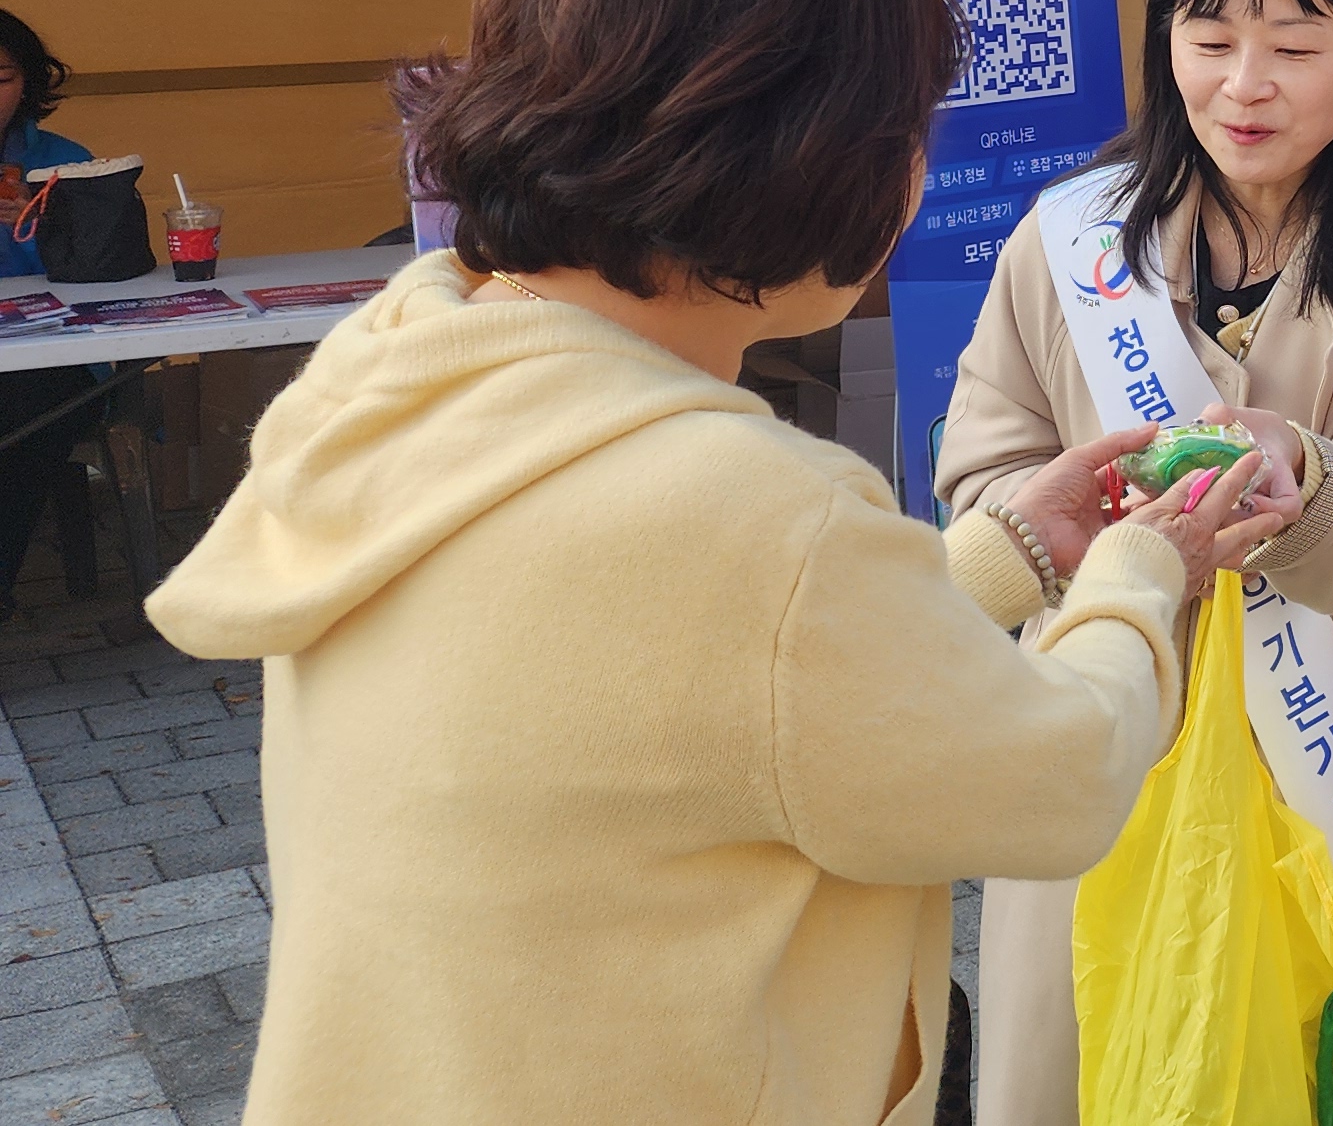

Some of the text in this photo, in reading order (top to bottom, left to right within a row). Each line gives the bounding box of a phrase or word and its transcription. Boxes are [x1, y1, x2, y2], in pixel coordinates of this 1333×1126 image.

[979, 125, 1037, 150] QR 하나로
[1029, 157, 1051, 174] 혼잡
[1053, 153, 1075, 170] 구역
[939, 166, 987, 189] 행사 정보
[945, 201, 1013, 229] 실시간 길찾기
[964, 240, 994, 264] 모두
